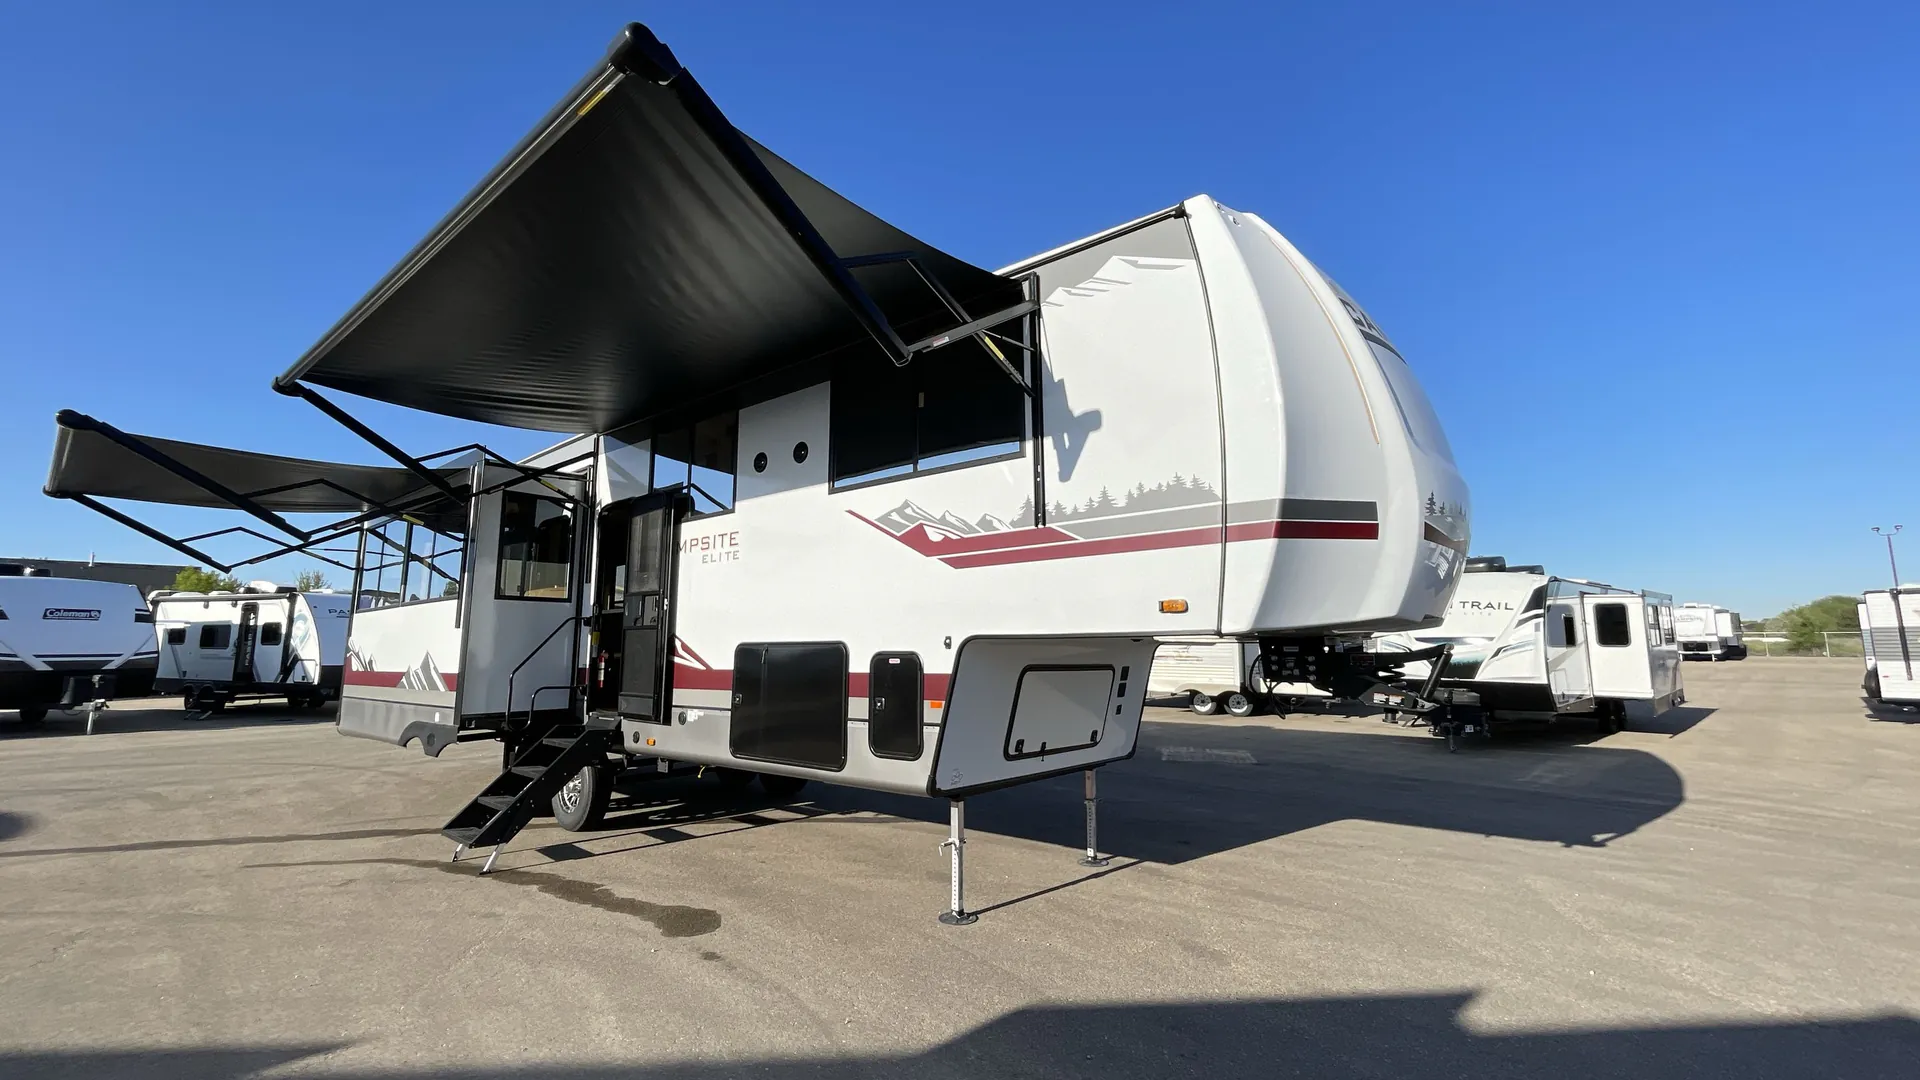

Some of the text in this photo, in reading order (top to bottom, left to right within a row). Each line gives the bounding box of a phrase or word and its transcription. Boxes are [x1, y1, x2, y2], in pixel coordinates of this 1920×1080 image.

[701, 550, 740, 564] ELITE
[1459, 601, 1514, 610] TRAIL
[46, 609, 90, 618] Coleman
